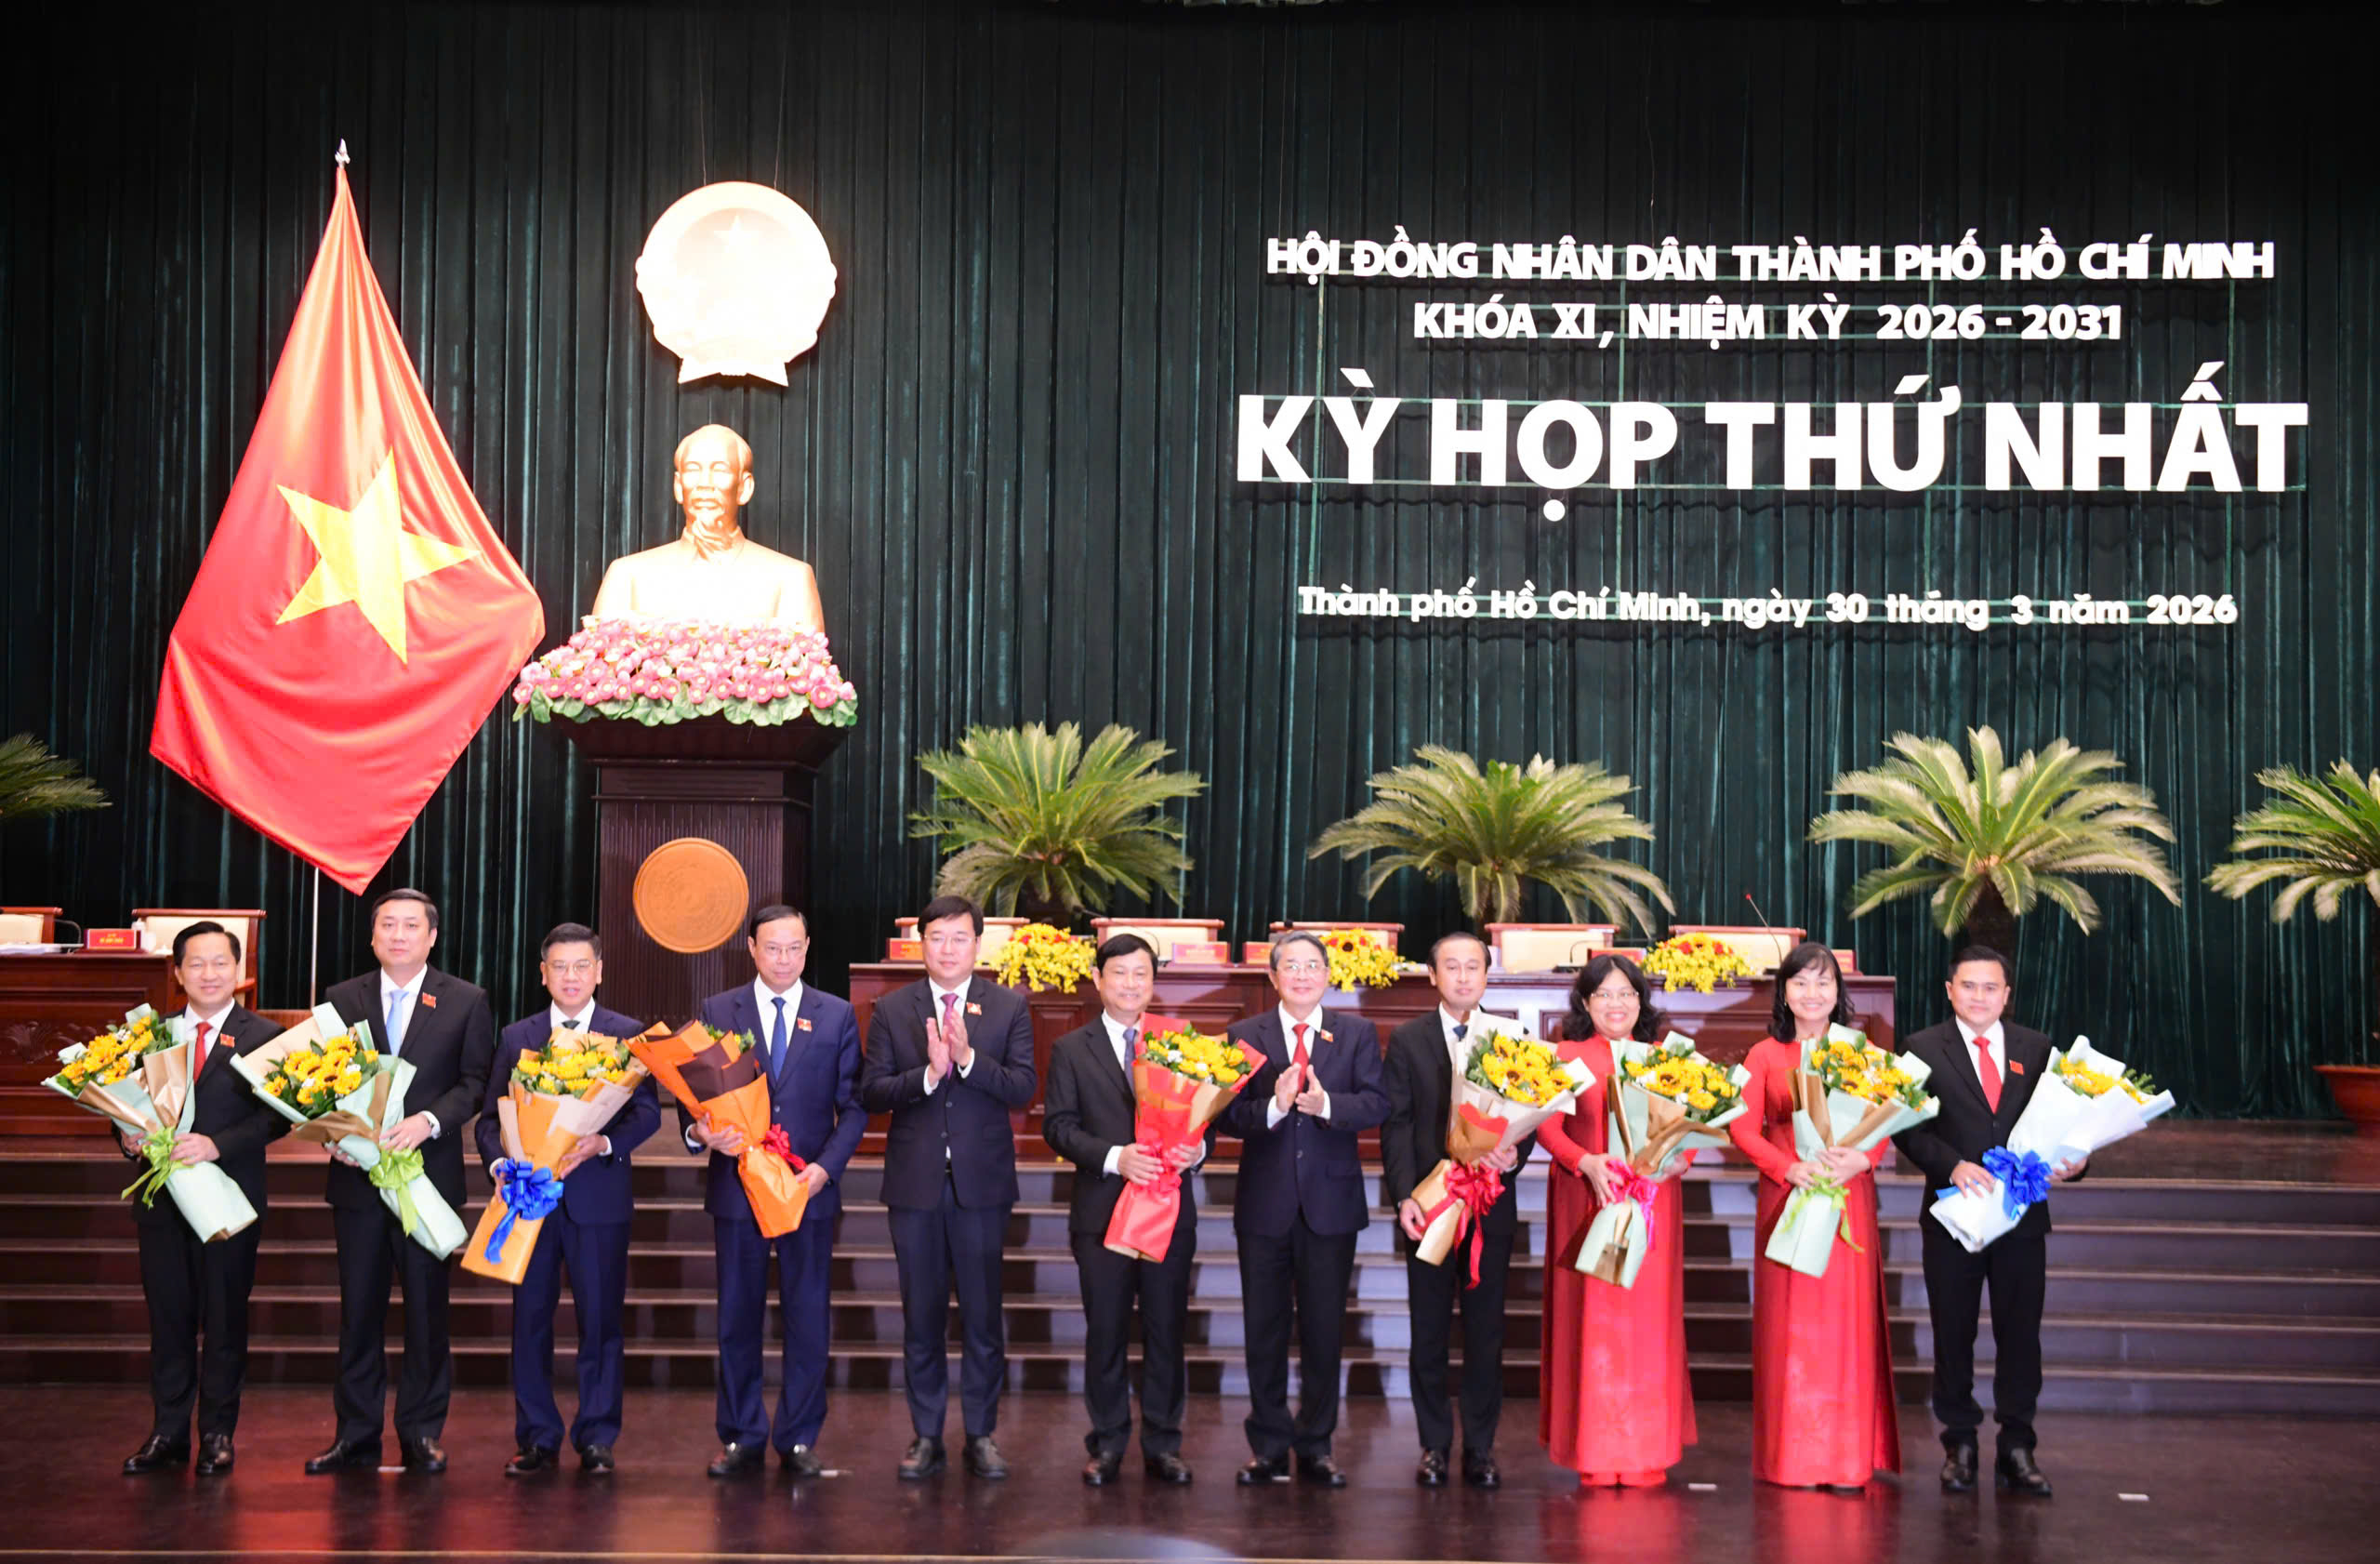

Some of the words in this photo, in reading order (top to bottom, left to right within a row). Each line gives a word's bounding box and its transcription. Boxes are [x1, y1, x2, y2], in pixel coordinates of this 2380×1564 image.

[1267, 231, 1339, 285] HỘI
[1350, 225, 1478, 279] ĐỒNG
[1491, 235, 1615, 281] NHÂN
[1625, 236, 1717, 282] DÂN
[1731, 235, 1883, 282] THÀNH
[1895, 228, 1986, 281] PHỐ
[2001, 227, 2065, 281] HỒ
[2079, 233, 2153, 280] CHÍ
[2162, 242, 2274, 280] MINH
[1414, 293, 1539, 339] KHÓA
[1629, 295, 1765, 351] NHIỆM
[1788, 293, 1851, 340] KỲ
[1876, 304, 1985, 340] 2026
[2018, 304, 2122, 340] 2031
[1237, 367, 1400, 484] KỲ
[1431, 398, 1678, 523] HỌP
[1704, 374, 1962, 492] THỨ
[1985, 361, 2308, 495] NHẤT
[1299, 583, 1400, 619] Thành
[1410, 576, 1478, 627] phố
[1490, 580, 1537, 622] Hồ
[1547, 586, 1609, 622] Chí
[1617, 590, 1712, 628] Minh,
[1720, 588, 1812, 630] ngày
[1826, 592, 1874, 622] 30
[1884, 590, 1990, 630] tháng
[2011, 594, 2033, 624] 3
[2048, 593, 2128, 624] năm
[2144, 593, 2239, 625] 2026
